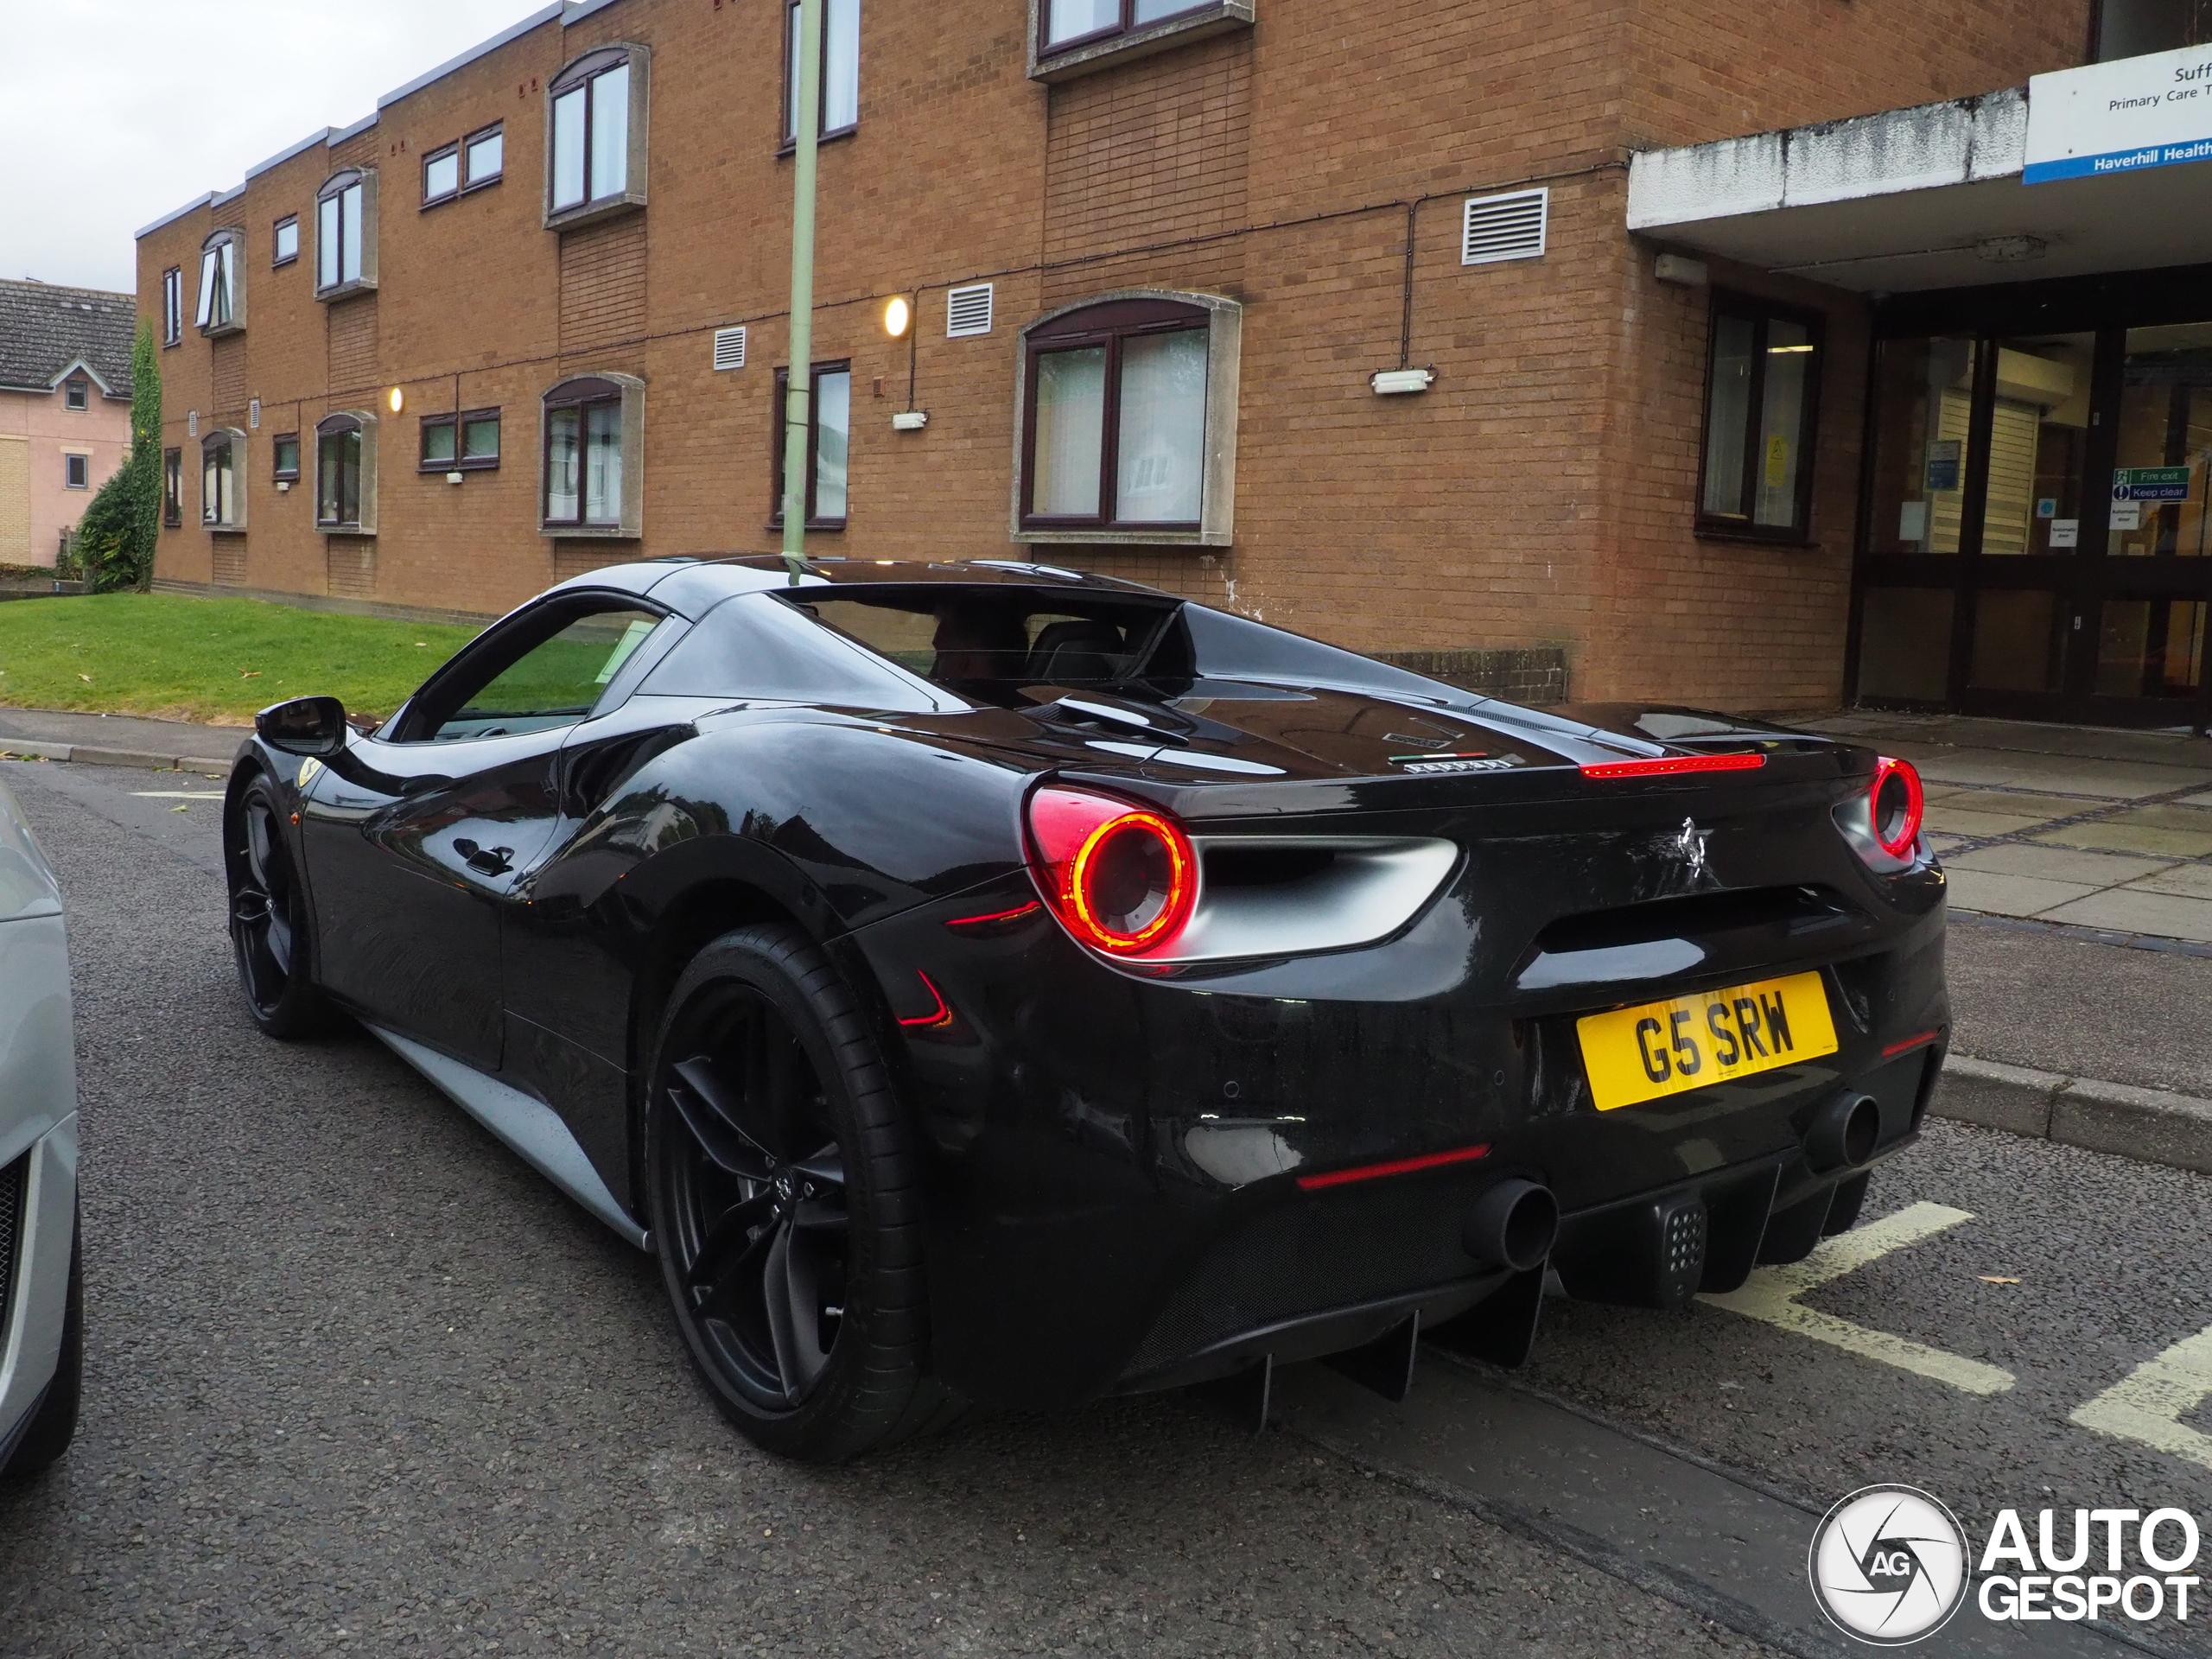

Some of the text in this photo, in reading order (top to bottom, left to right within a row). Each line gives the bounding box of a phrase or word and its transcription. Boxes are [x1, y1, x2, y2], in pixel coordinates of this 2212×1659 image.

[2109, 94, 2160, 111] Primary
[2167, 89, 2197, 101] Care
[2094, 149, 2158, 170] Haverhill
[2140, 471, 2178, 480] Fire exit
[2133, 487, 2183, 498] Keep clear
[1636, 991, 1794, 1083] G5 SRW
